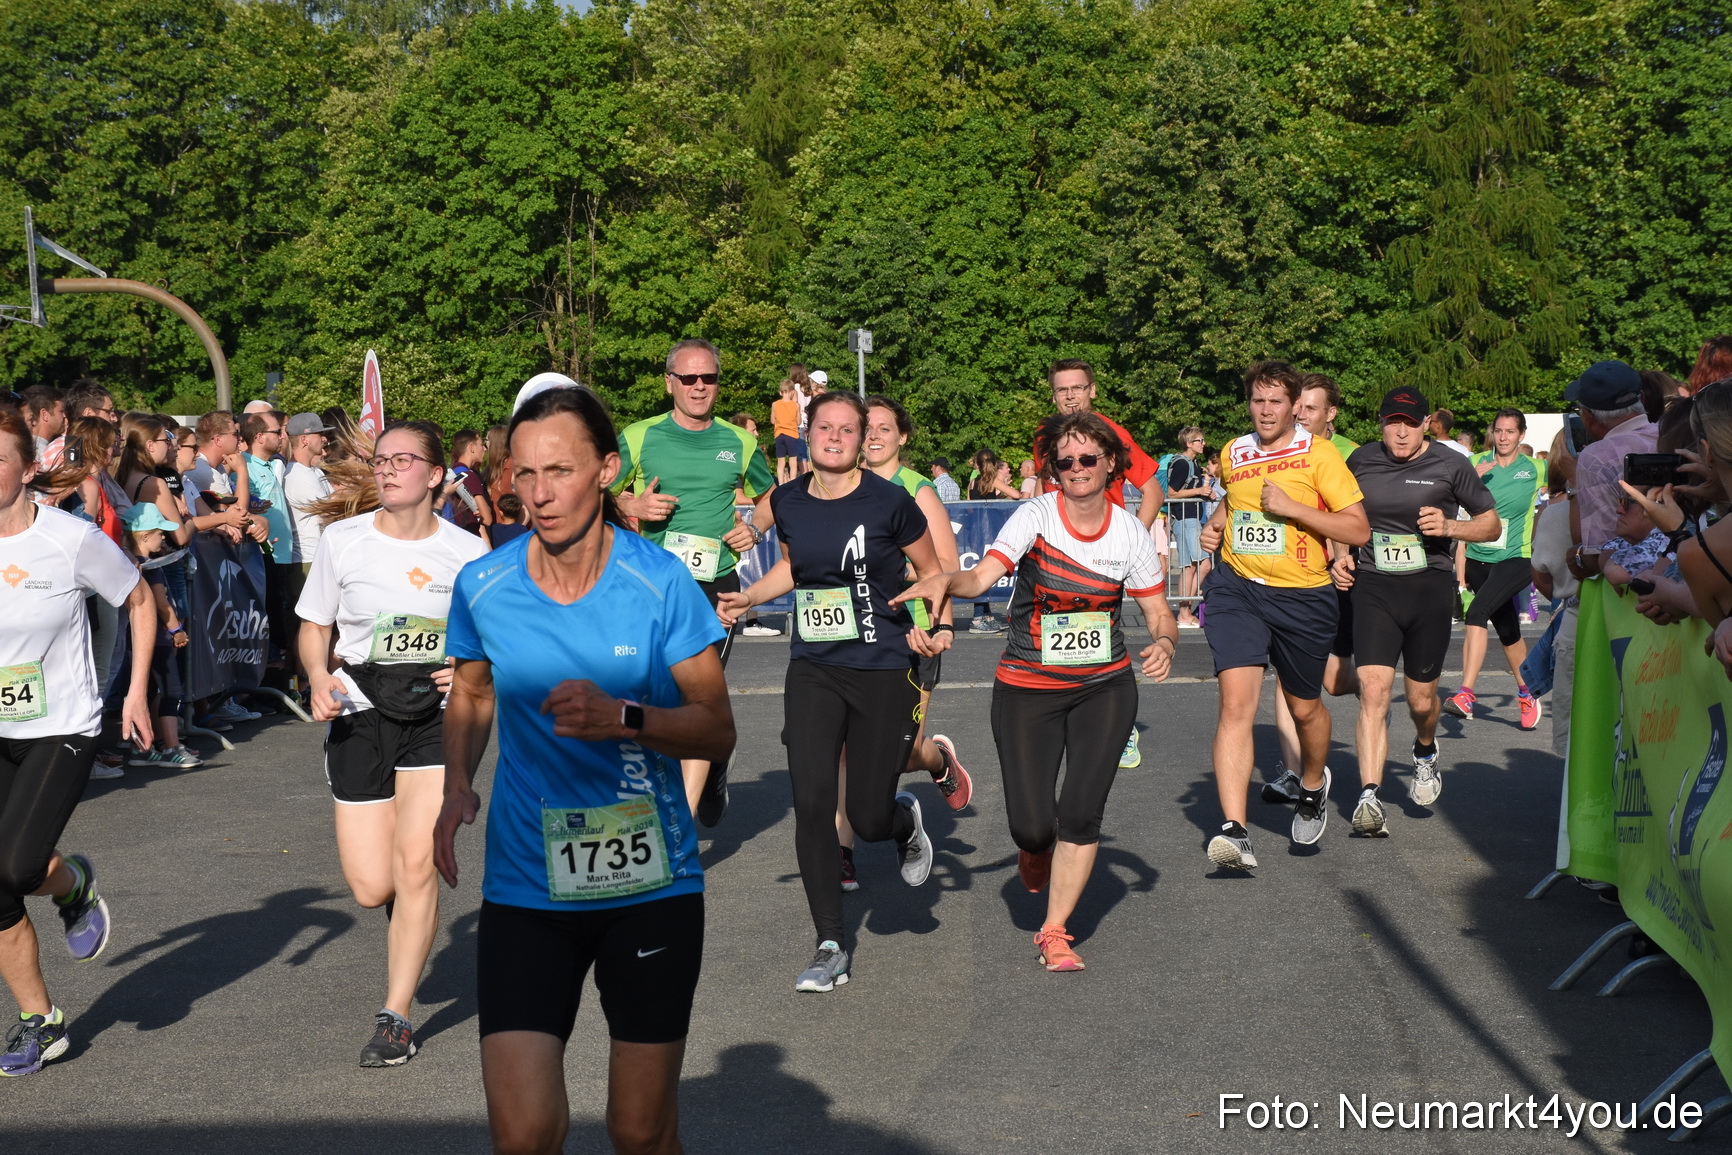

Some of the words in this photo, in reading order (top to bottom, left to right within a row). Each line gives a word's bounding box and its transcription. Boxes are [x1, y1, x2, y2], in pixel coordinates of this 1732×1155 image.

[715, 450, 737, 461] AOK
[1229, 467, 1261, 484] MAX
[1267, 458, 1311, 474] BÖGL
[1237, 525, 1278, 544] 1633
[1383, 547, 1411, 561] 171
[803, 607, 846, 627] 1950
[383, 632, 440, 653] 1348
[1050, 630, 1102, 651] 2268
[614, 645, 637, 657] Rita
[1077, 649, 1096, 657] Brigitte
[1, 683, 34, 707] 54
[634, 819, 654, 832] 2019
[560, 831, 652, 874] 1735
[586, 874, 609, 883] Marx
[612, 871, 631, 880] Rita
[602, 877, 645, 889] Lengenfelder
